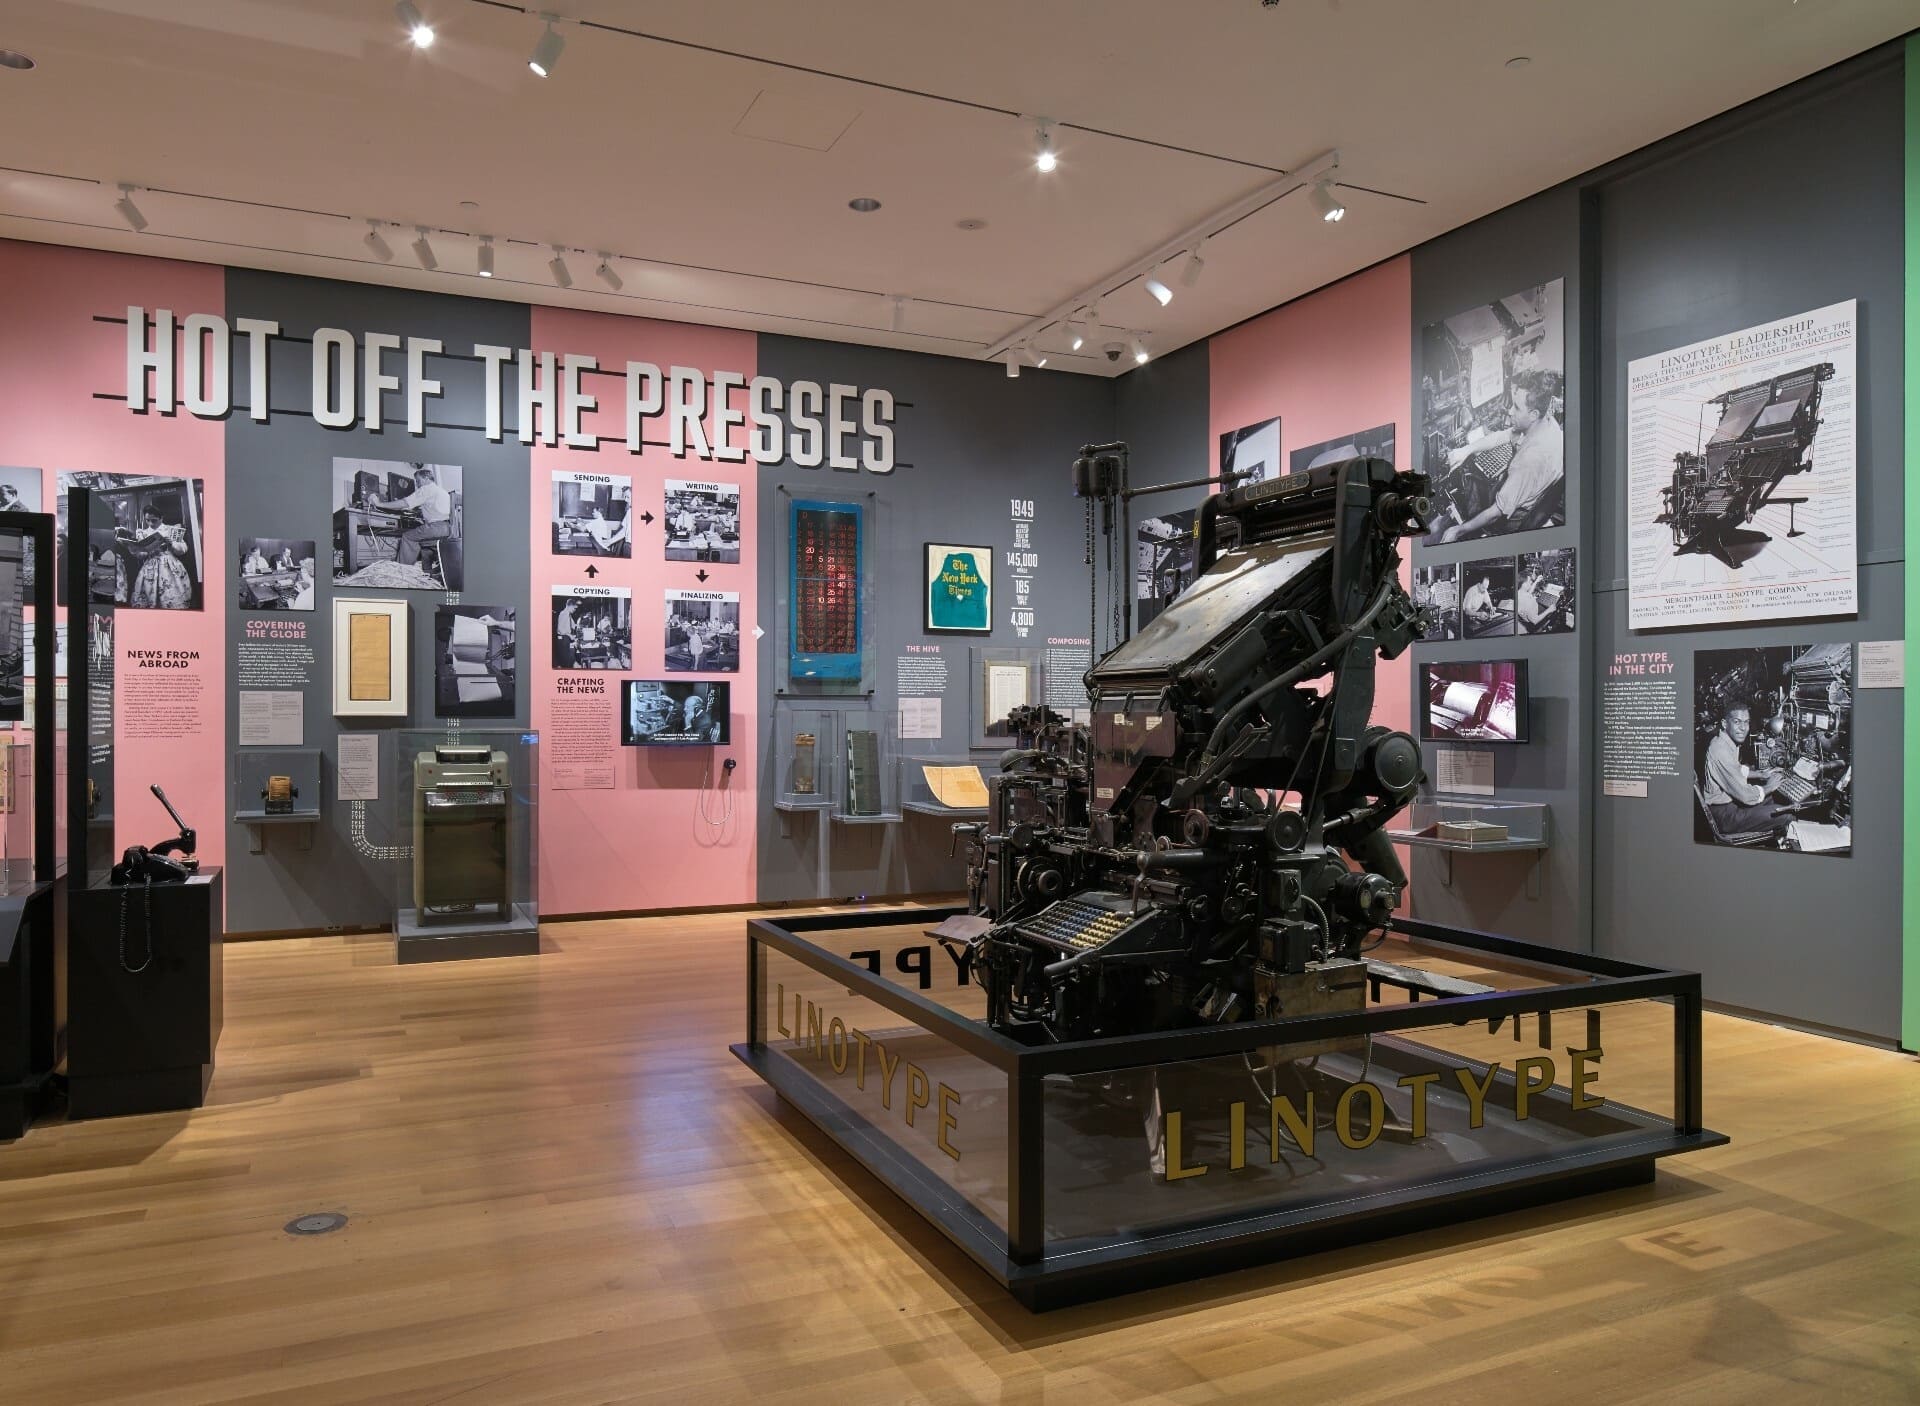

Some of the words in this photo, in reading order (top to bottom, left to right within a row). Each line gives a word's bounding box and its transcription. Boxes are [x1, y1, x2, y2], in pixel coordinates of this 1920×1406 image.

[1661, 344, 1722, 368] LINOTYPE
[1730, 319, 1814, 350] LEADERSHIP
[1632, 370, 1658, 384] BRINGS
[1661, 365, 1683, 376] THESE
[1687, 352, 1732, 369] IMPORTANT
[1735, 341, 1777, 356] FEATURES
[1780, 332, 1803, 345] THAT
[1807, 326, 1828, 339] SAVE
[1832, 320, 1851, 332] THE
[1632, 375, 1674, 390] OPERATOR'S
[1679, 369, 1695, 380] TIME
[1700, 363, 1716, 373] AND
[1718, 356, 1736, 367] GIVE
[1740, 345, 1787, 361] INCREASED
[1791, 328, 1851, 350] PRODUCTION
[127, 305, 280, 420] HOT
[312, 327, 443, 434] OFF
[475, 343, 599, 447] THE
[626, 361, 894, 474] PRESSES
[574, 473, 611, 483] SENDING
[686, 481, 719, 491] WRITING
[1010, 499, 1034, 517] 1949
[805, 546, 815, 554] 20
[818, 555, 824, 563] 5
[1007, 552, 1038, 567] 145,000
[827, 564, 836, 572] 22
[952, 559, 968, 571] The
[942, 572, 958, 583] New
[959, 572, 978, 585] York
[838, 581, 847, 589] 40
[1016, 580, 1029, 594] 185
[573, 587, 611, 596] COPYING
[681, 591, 724, 600] FINALIZING
[948, 585, 972, 596] Times
[1664, 593, 1722, 604] MERGENTHALER
[1726, 588, 1765, 600] LINOTYPE
[1768, 584, 1808, 596] COMPANY
[1011, 611, 1034, 626] 4,800
[247, 620, 306, 630] COVERING
[246, 629, 266, 638] THE
[269, 630, 307, 639] GLOBE
[1047, 637, 1091, 646] COMPOSING
[906, 645, 920, 653] THE
[922, 645, 941, 653] HIVE
[128, 650, 162, 659] NEWS
[166, 651, 200, 660] FROM
[1615, 654, 1638, 664] HOT
[1640, 652, 1668, 663] TYPE
[139, 660, 189, 668] ABROAD
[1609, 665, 1622, 675] IN
[1625, 664, 1646, 675] THE
[1649, 663, 1674, 674] CITY
[557, 678, 605, 686] CRAFTING
[557, 686, 574, 694] THE
[577, 686, 605, 694] NEWS
[777, 983, 962, 1162] LINOTYPE
[1165, 1047, 1605, 1182] LINOTYPE
